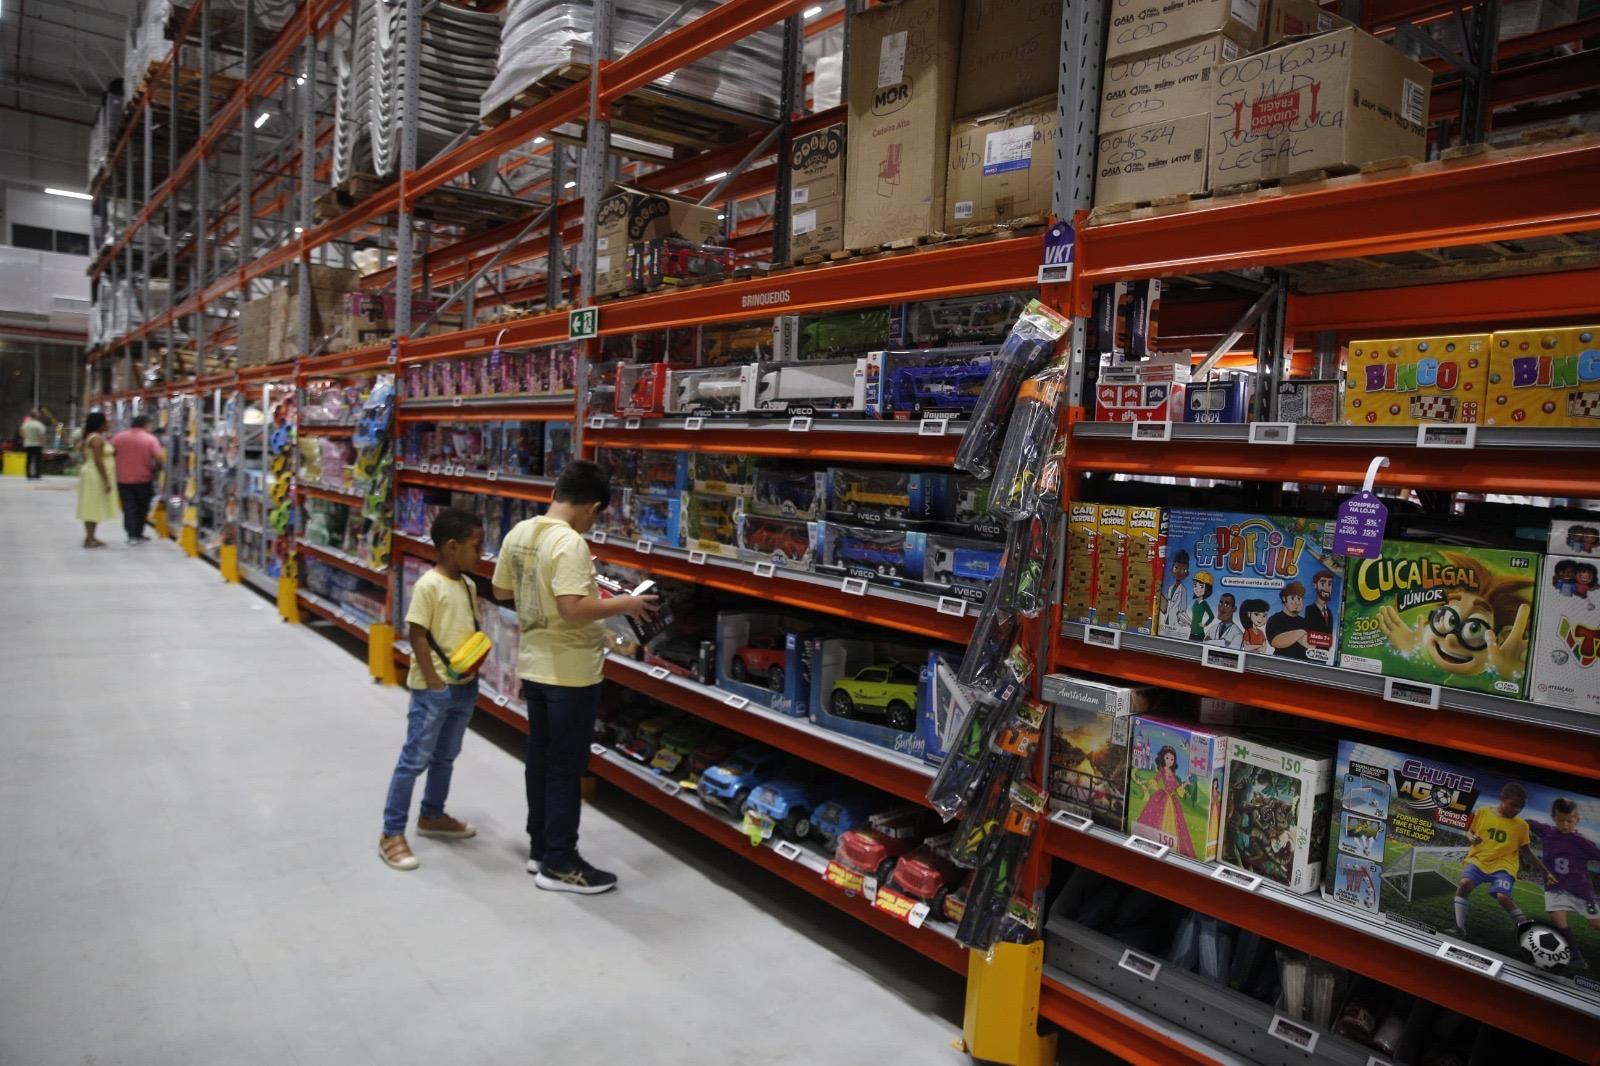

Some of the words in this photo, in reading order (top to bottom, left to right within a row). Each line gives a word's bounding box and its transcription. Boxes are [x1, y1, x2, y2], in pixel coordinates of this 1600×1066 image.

[1117, 21, 1168, 44] COD
[875, 83, 908, 108] MOR
[1110, 99, 1164, 118] COD
[1252, 109, 1300, 127] CUIDADO
[1107, 148, 1146, 165] COD
[1044, 243, 1074, 264] VKT
[742, 290, 790, 306] BRINQUEDOS
[1365, 358, 1459, 392] BINGO
[788, 407, 813, 416] IVECO
[924, 411, 960, 420] Voyager
[857, 513, 881, 522] IVECO
[1073, 507, 1095, 515] CAIU
[1102, 509, 1126, 518] CAIU
[1132, 511, 1156, 520] CAIU
[974, 524, 1000, 534] IVECO
[1196, 525, 1305, 578] #Partiu!
[850, 569, 874, 579] IVECO
[954, 586, 983, 598] IVECO
[1400, 589, 1443, 609] JÚNIOR
[1354, 620, 1378, 631] 300
[1057, 687, 1099, 704] Amsterdam
[894, 734, 925, 754] Surfing
[1280, 756, 1301, 774] 150
[1401, 759, 1475, 792] CHUTE
[1400, 781, 1411, 795] A
[1413, 781, 1468, 811] GOL
[1396, 813, 1419, 825] FORME
[1418, 819, 1432, 828] SEU
[1437, 808, 1457, 820] Treino
[1438, 815, 1466, 828] Torneio
[1392, 819, 1407, 830] TIME
[1395, 827, 1411, 837] ESTE
[1158, 833, 1174, 848] 150
[1487, 827, 1507, 843] 10
[1555, 857, 1569, 874] 8
[1496, 879, 1510, 890] 10
